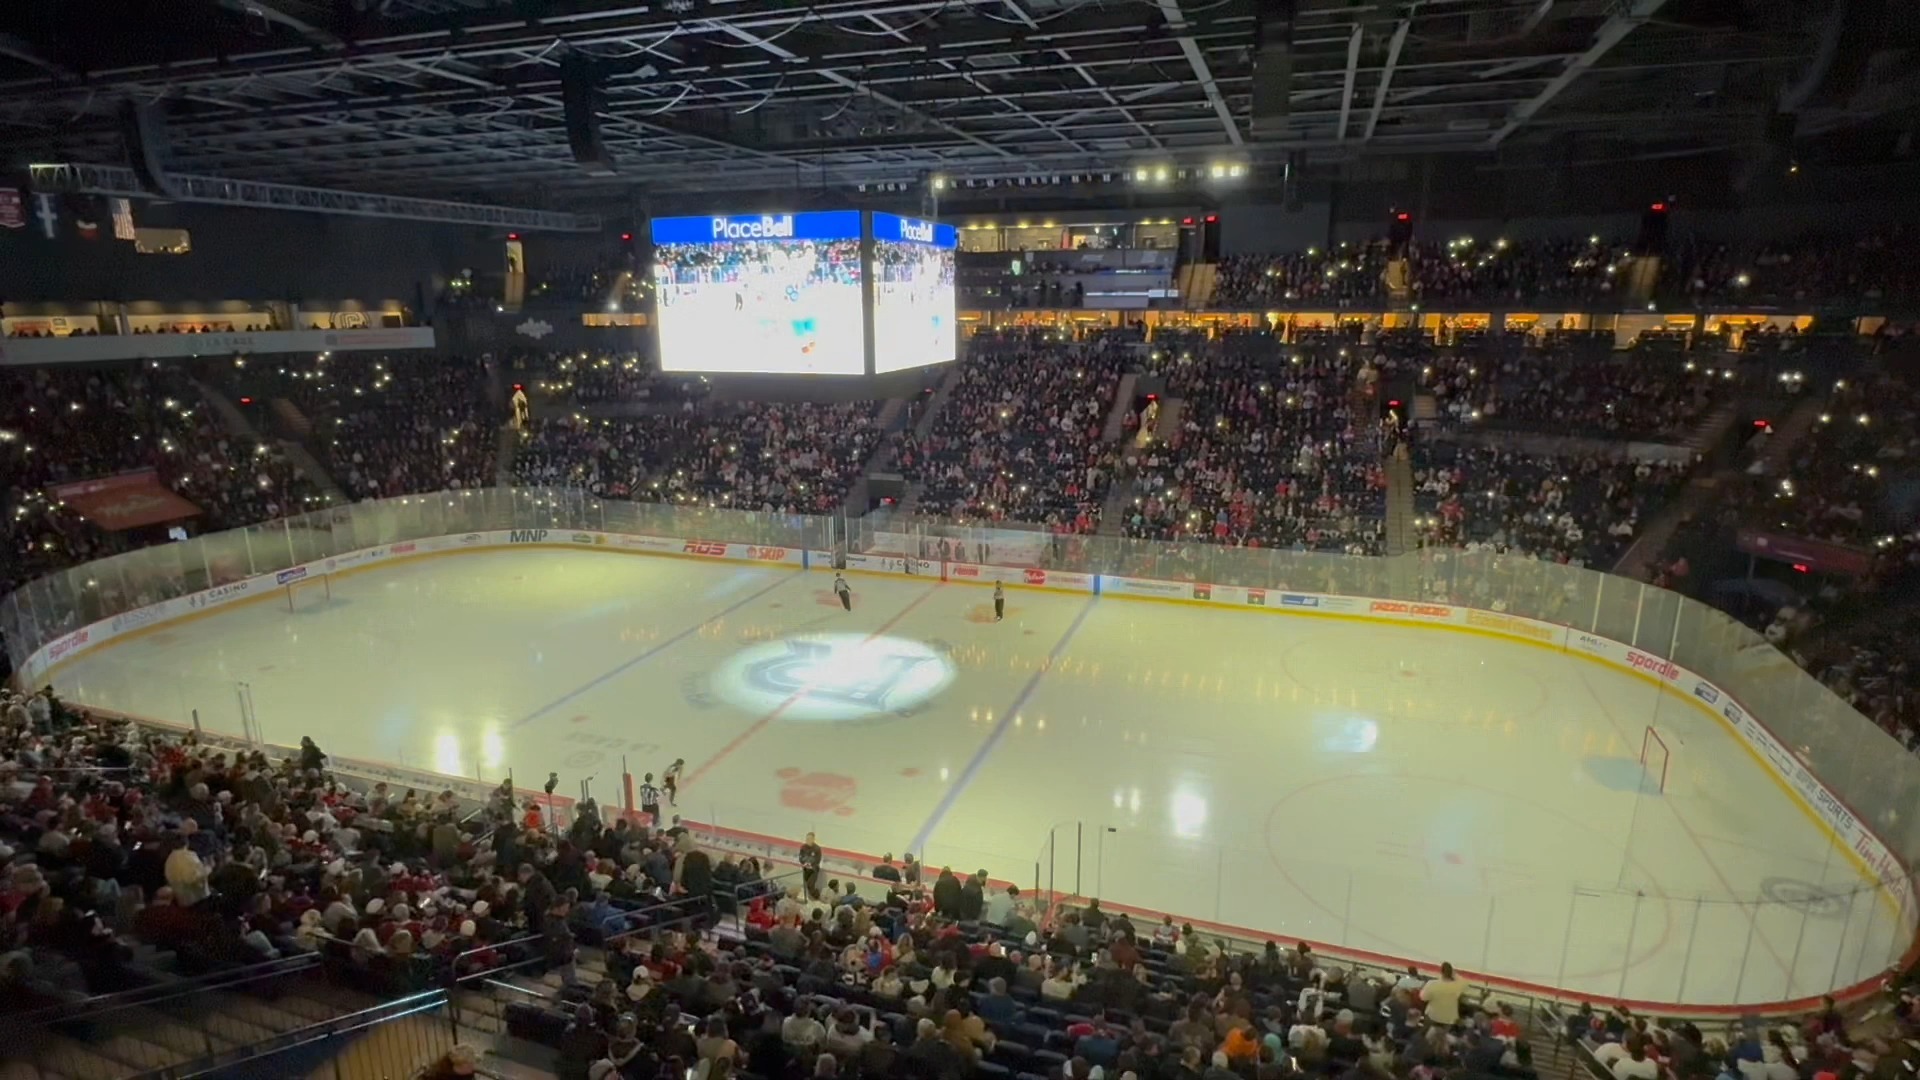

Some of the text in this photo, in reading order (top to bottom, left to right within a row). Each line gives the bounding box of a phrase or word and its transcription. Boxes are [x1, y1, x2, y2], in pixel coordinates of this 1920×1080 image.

[510, 530, 548, 543] MNP
[758, 547, 785, 561] SKIP
[208, 582, 248, 599] CASINO
[1626, 651, 1690, 680] spordle
[1817, 788, 1854, 830] SPORTS
